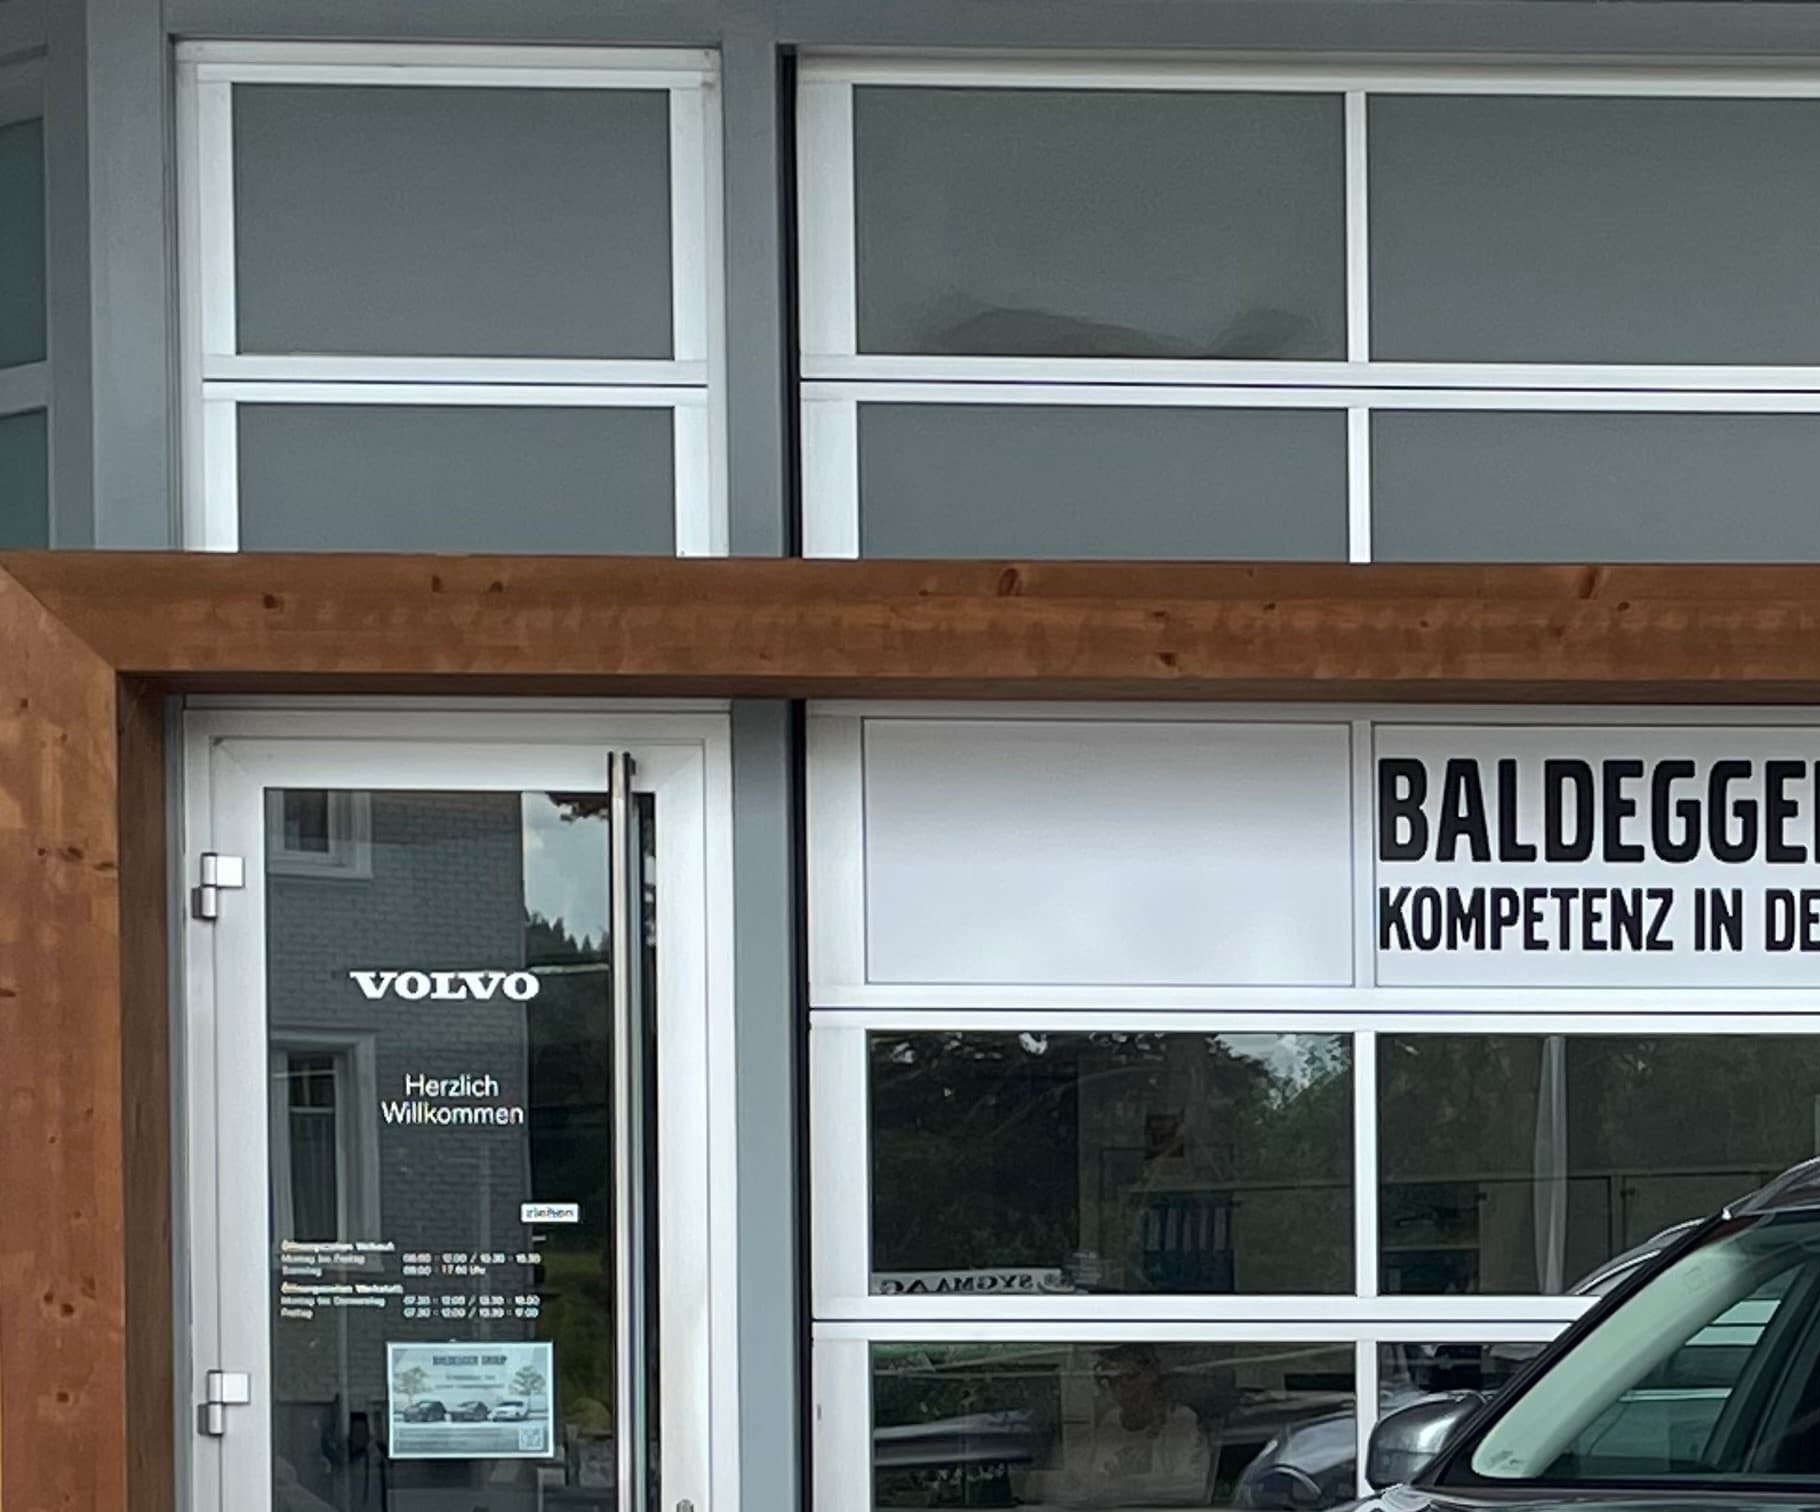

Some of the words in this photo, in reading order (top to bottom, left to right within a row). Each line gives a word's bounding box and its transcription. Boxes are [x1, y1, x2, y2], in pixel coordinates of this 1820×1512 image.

[1378, 886, 1674, 951] KOMPETENZ
[1694, 887, 1743, 951] IN
[350, 970, 540, 1000] VOLVO
[405, 1073, 498, 1097] Herzlich
[381, 1101, 524, 1125] Willkommen
